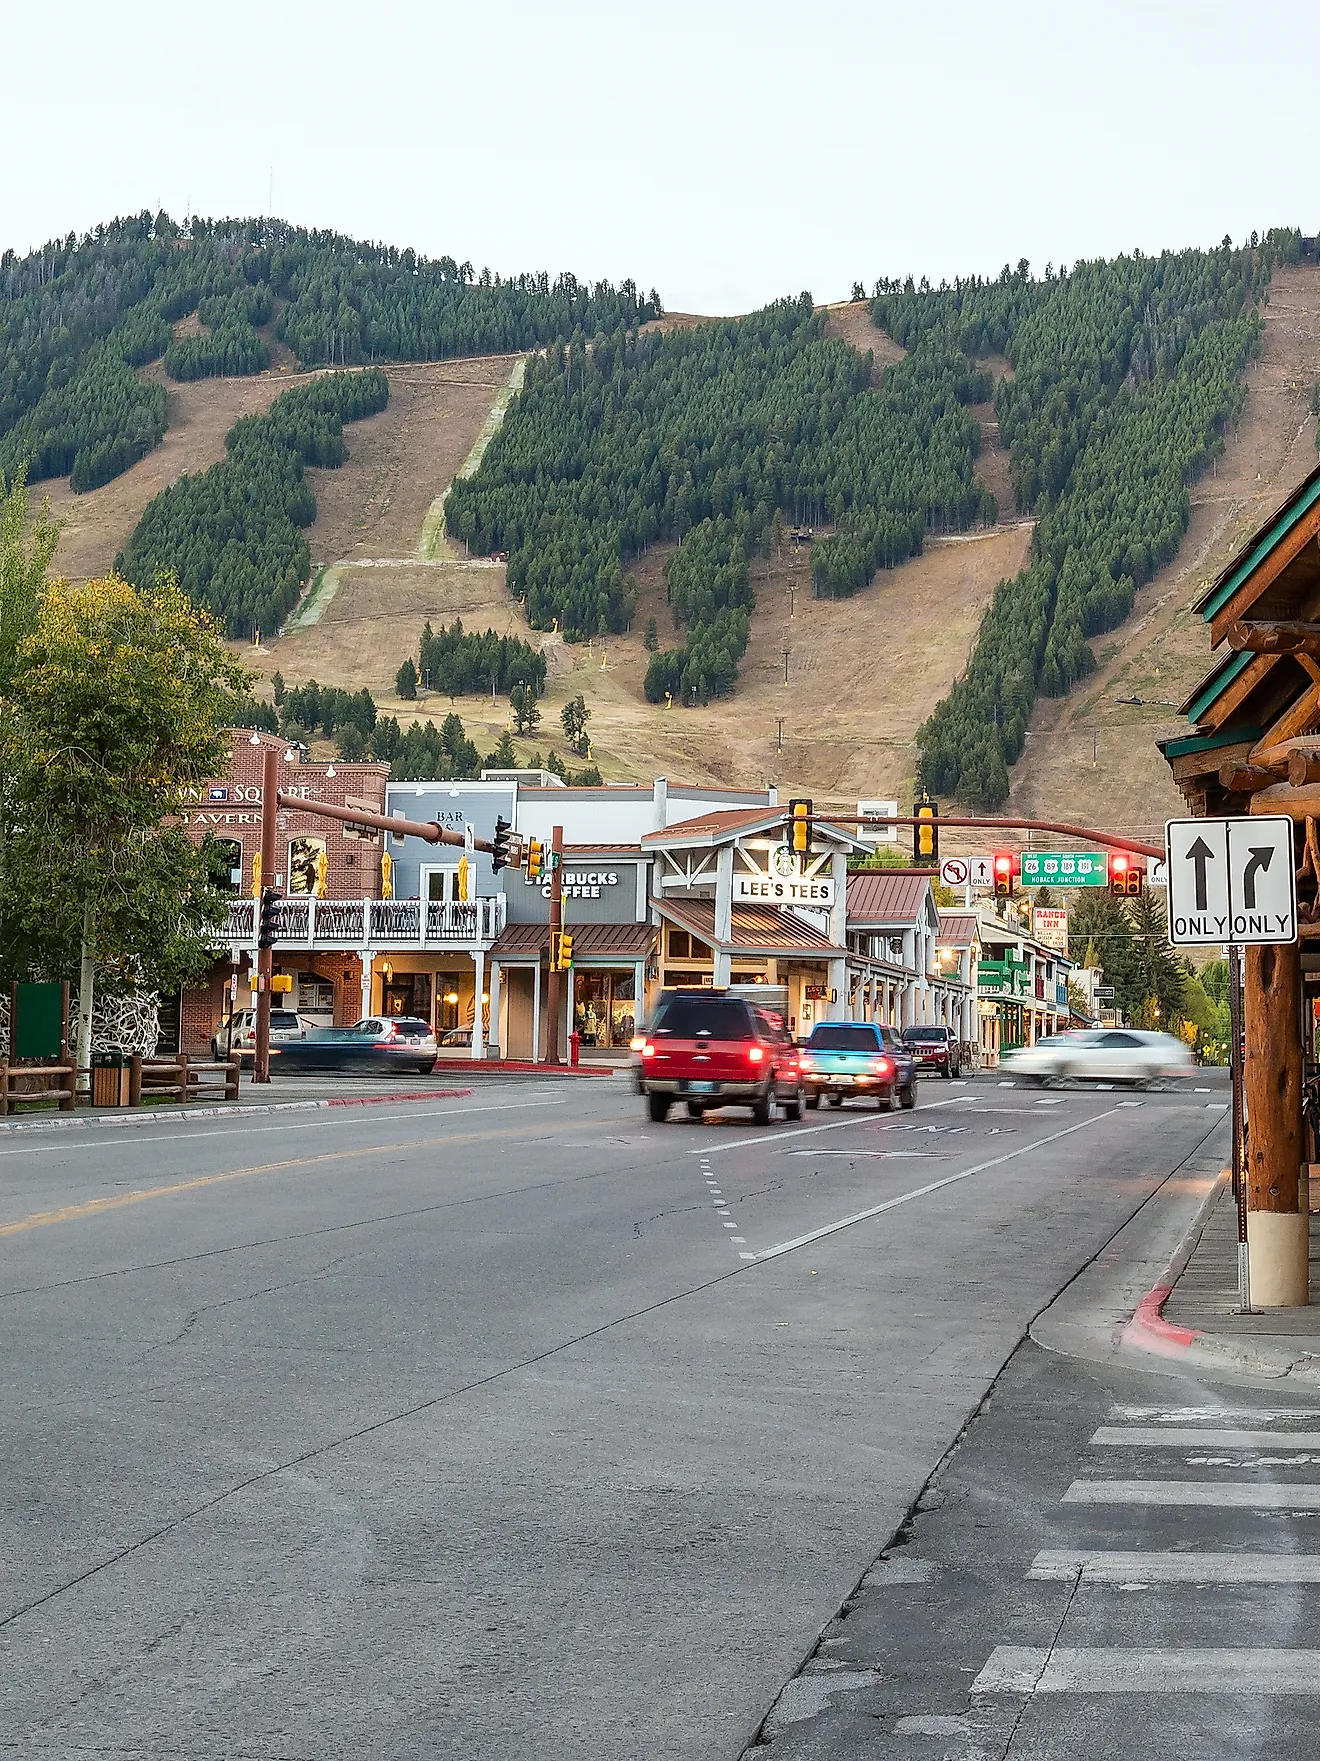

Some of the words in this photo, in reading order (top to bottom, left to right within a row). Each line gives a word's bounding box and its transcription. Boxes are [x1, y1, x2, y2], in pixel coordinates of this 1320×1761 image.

[437, 811, 464, 821] BAR
[1027, 862, 1037, 871] 26
[1046, 863, 1056, 871] 89
[541, 886, 601, 898] CFFEE
[740, 882, 784, 896] LEE'S
[790, 884, 829, 898] TEES
[1036, 910, 1066, 919] RANCH
[1043, 920, 1059, 928] INN
[1175, 916, 1227, 935] ONLY
[1234, 915, 1289, 934] ONLY
